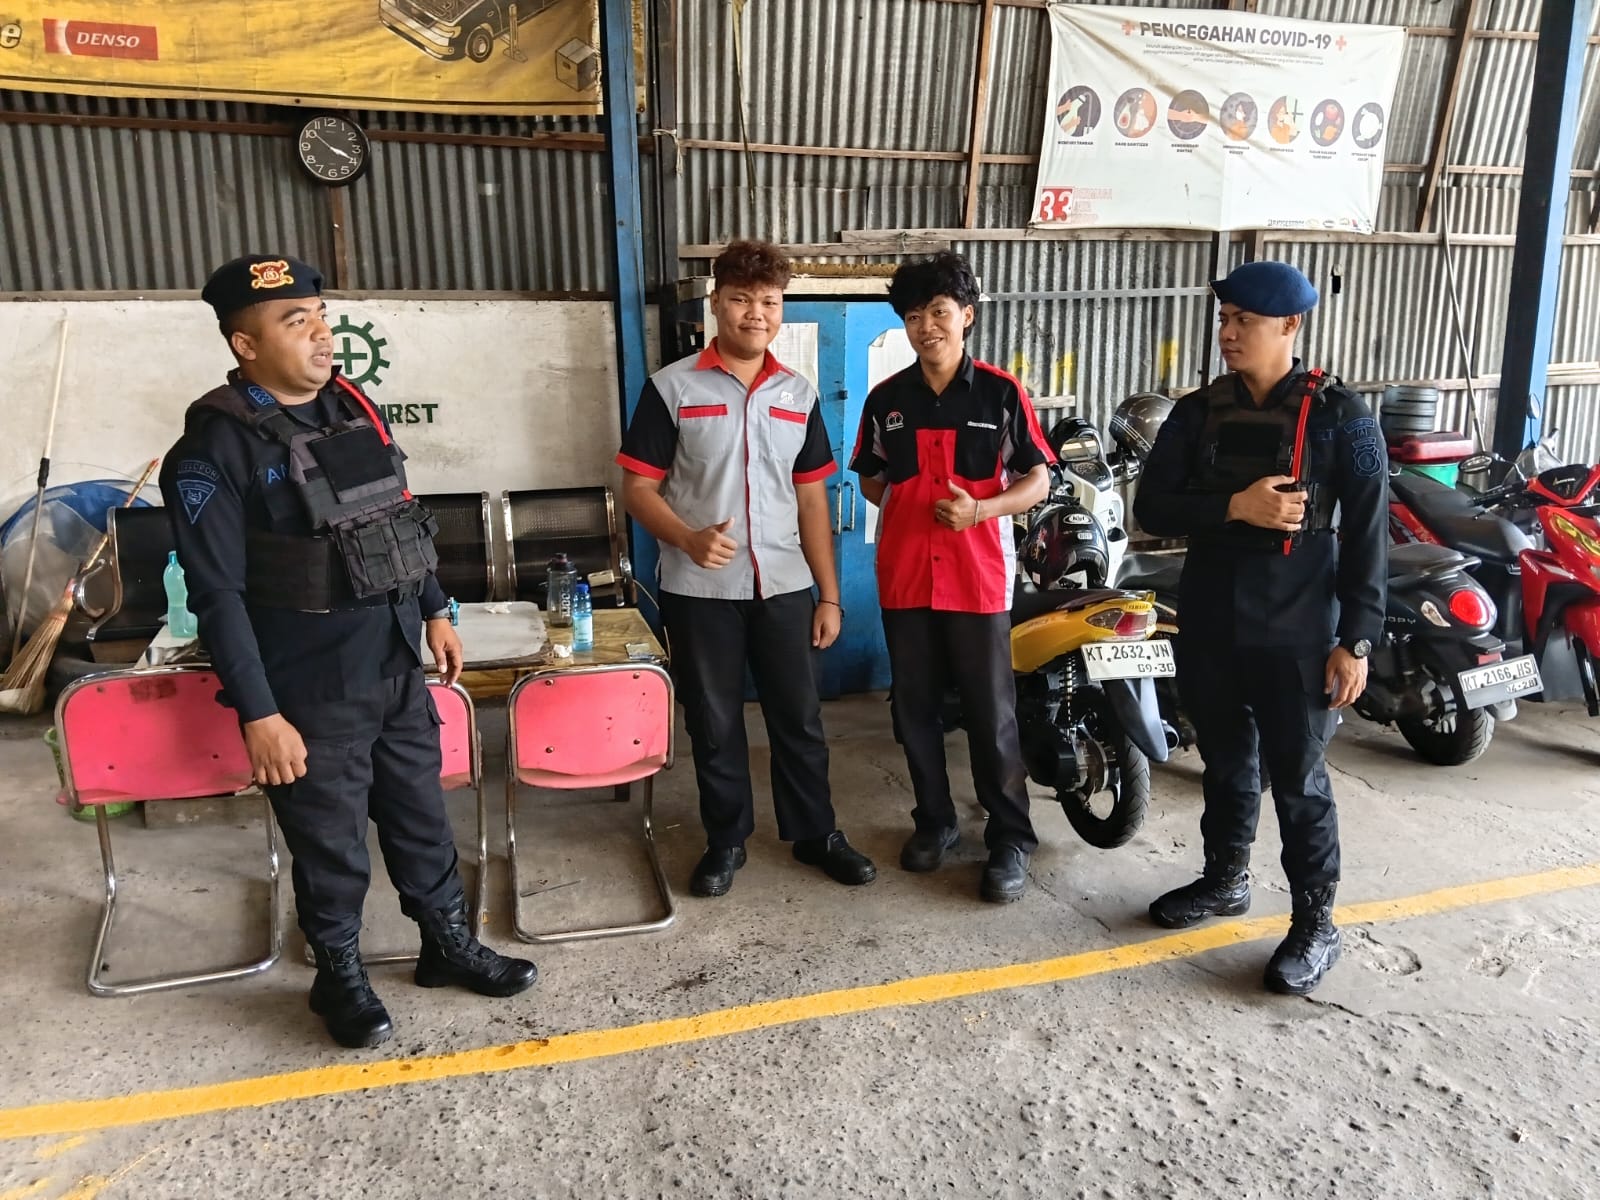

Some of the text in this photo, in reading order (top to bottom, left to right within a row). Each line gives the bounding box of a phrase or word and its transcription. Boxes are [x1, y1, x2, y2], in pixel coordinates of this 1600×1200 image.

[76, 31, 140, 48] DENSO
[1139, 22, 1332, 50] PENCEGAHAN COVID-19
[314, 121, 320, 130] 11
[324, 118, 337, 127] 12
[341, 122, 345, 131] 1
[305, 129, 317, 138] 10
[347, 132, 357, 141] 2
[301, 142, 311, 151] 9
[352, 144, 361, 154] 3
[306, 155, 316, 164] 8
[348, 157, 358, 166] 4
[315, 164, 325, 173] 7
[328, 168, 338, 178] 6
[340, 165, 350, 175] 5
